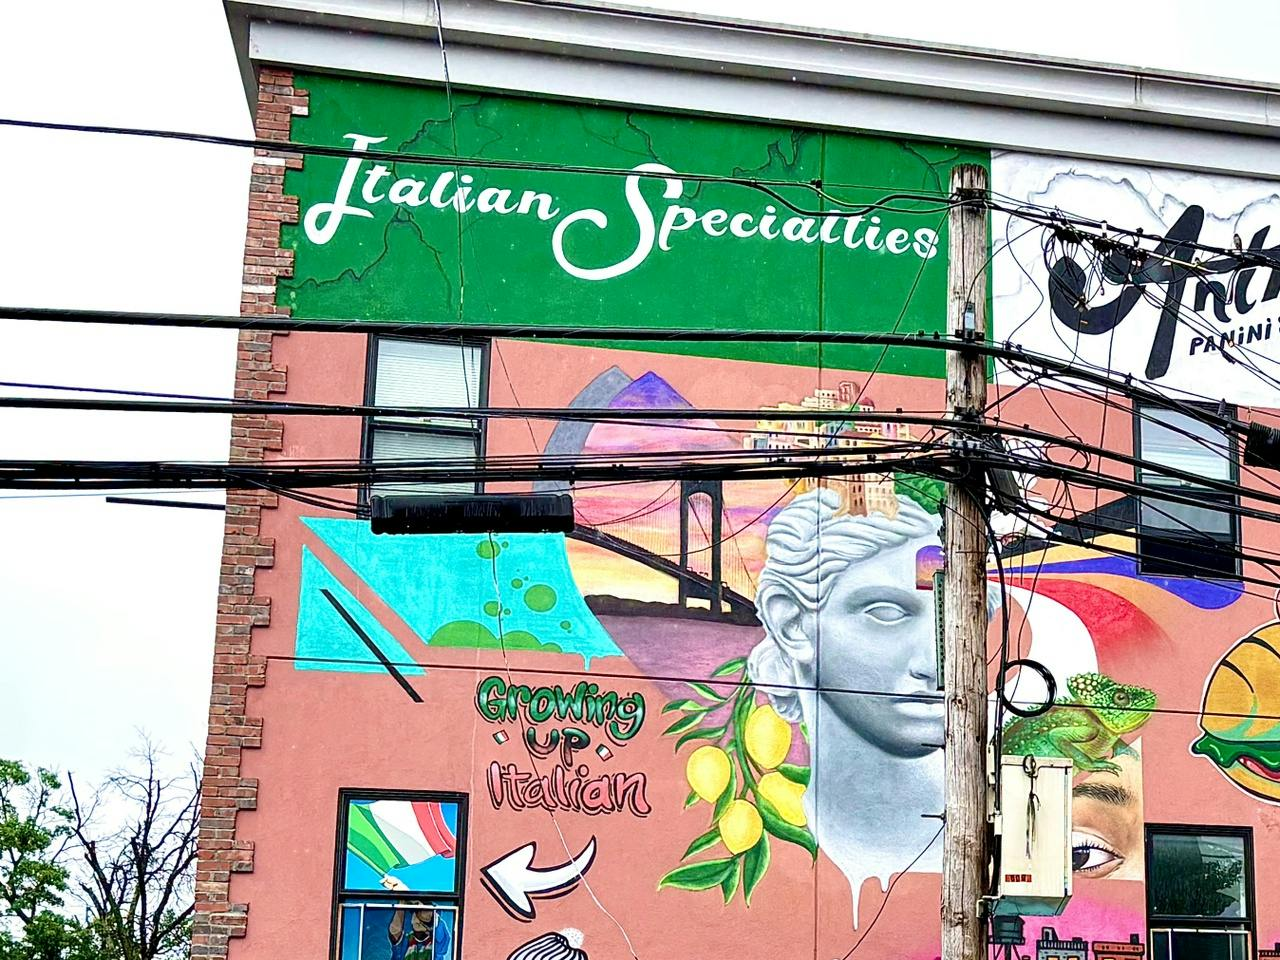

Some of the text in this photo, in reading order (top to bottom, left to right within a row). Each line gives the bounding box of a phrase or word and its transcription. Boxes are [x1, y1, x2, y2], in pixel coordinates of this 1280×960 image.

[303, 133, 940, 281] Italian Specialties
[476, 675, 646, 742] Growing
[488, 760, 652, 817] Italian
